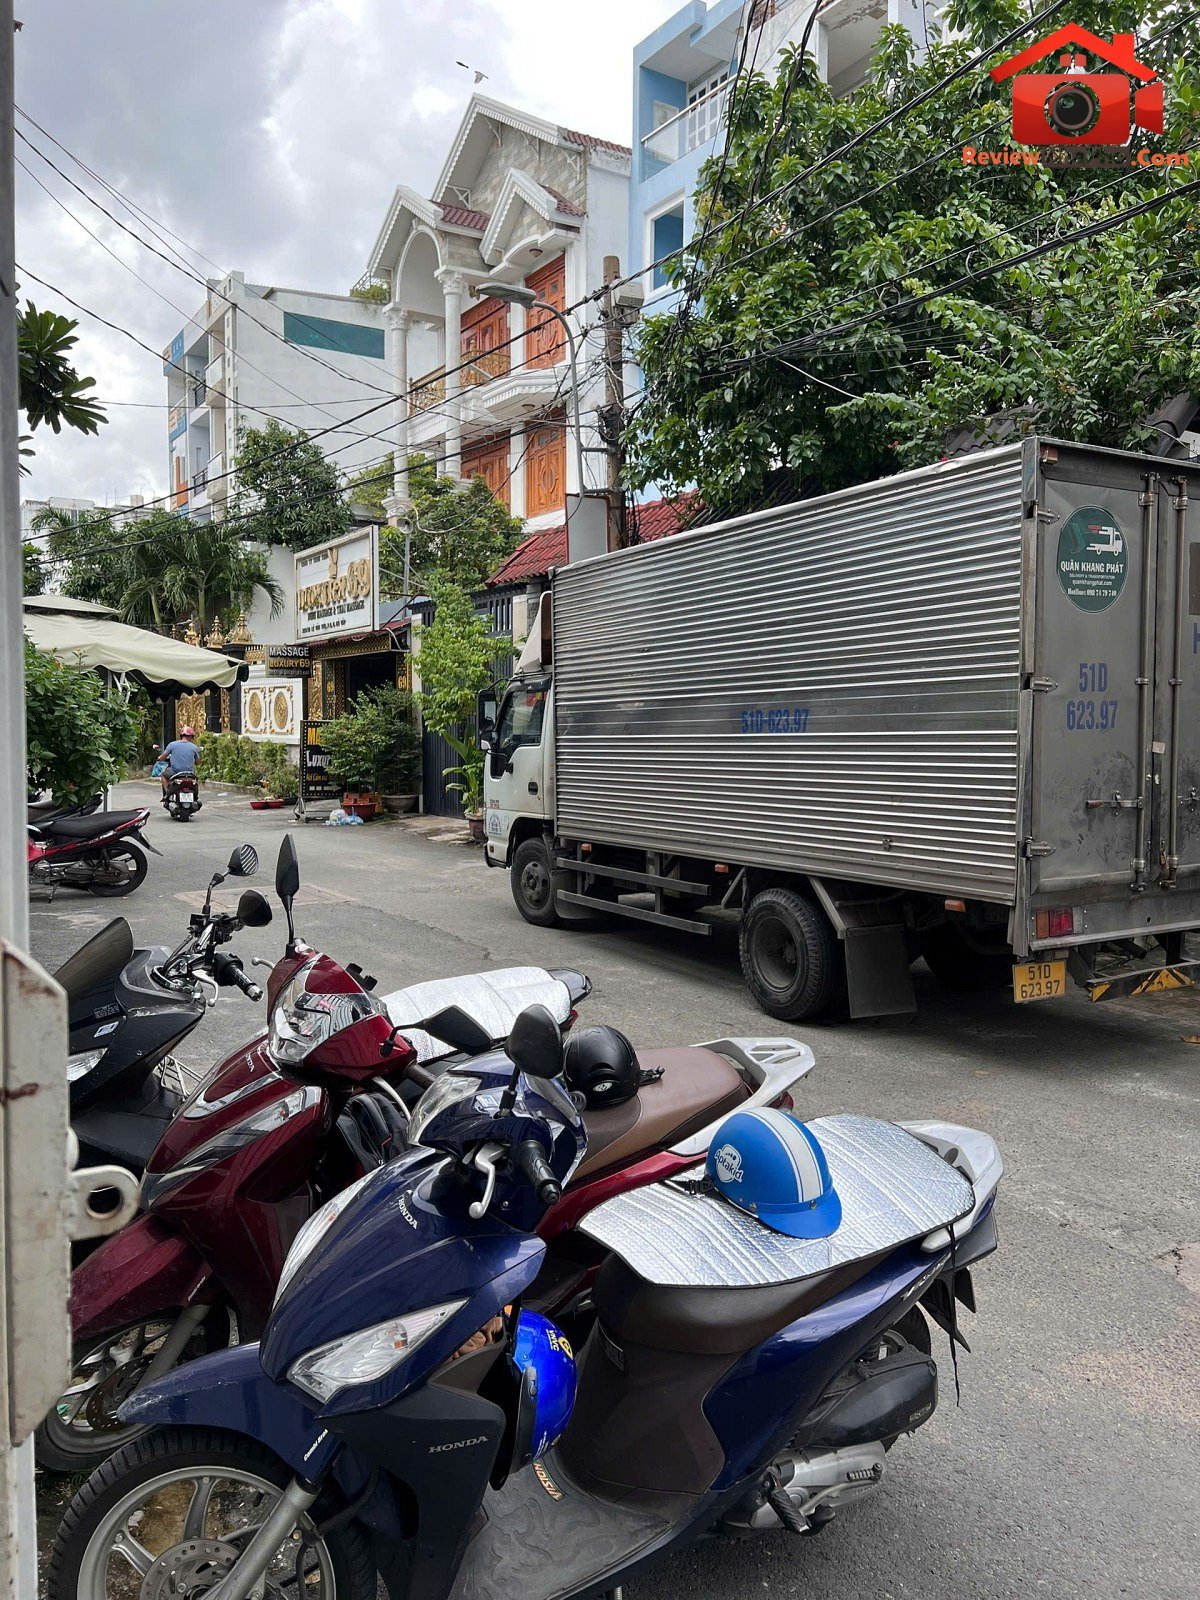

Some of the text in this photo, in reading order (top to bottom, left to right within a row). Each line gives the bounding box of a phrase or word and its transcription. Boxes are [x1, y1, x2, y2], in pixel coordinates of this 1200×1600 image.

[1060, 559, 1124, 574] QUÂN KHANG PHÁT
[268, 646, 310, 657] MASSAGE
[269, 659, 311, 668] LUXURY 69
[1079, 662, 1108, 692] 51D
[741, 707, 809, 733] 51D-623.97
[1066, 700, 1119, 731] 623.97
[1028, 964, 1051, 980] 51D
[1020, 980, 1061, 999] 623.97
[397, 1195, 418, 1230] HONDA
[428, 1435, 489, 1454] HONDA
